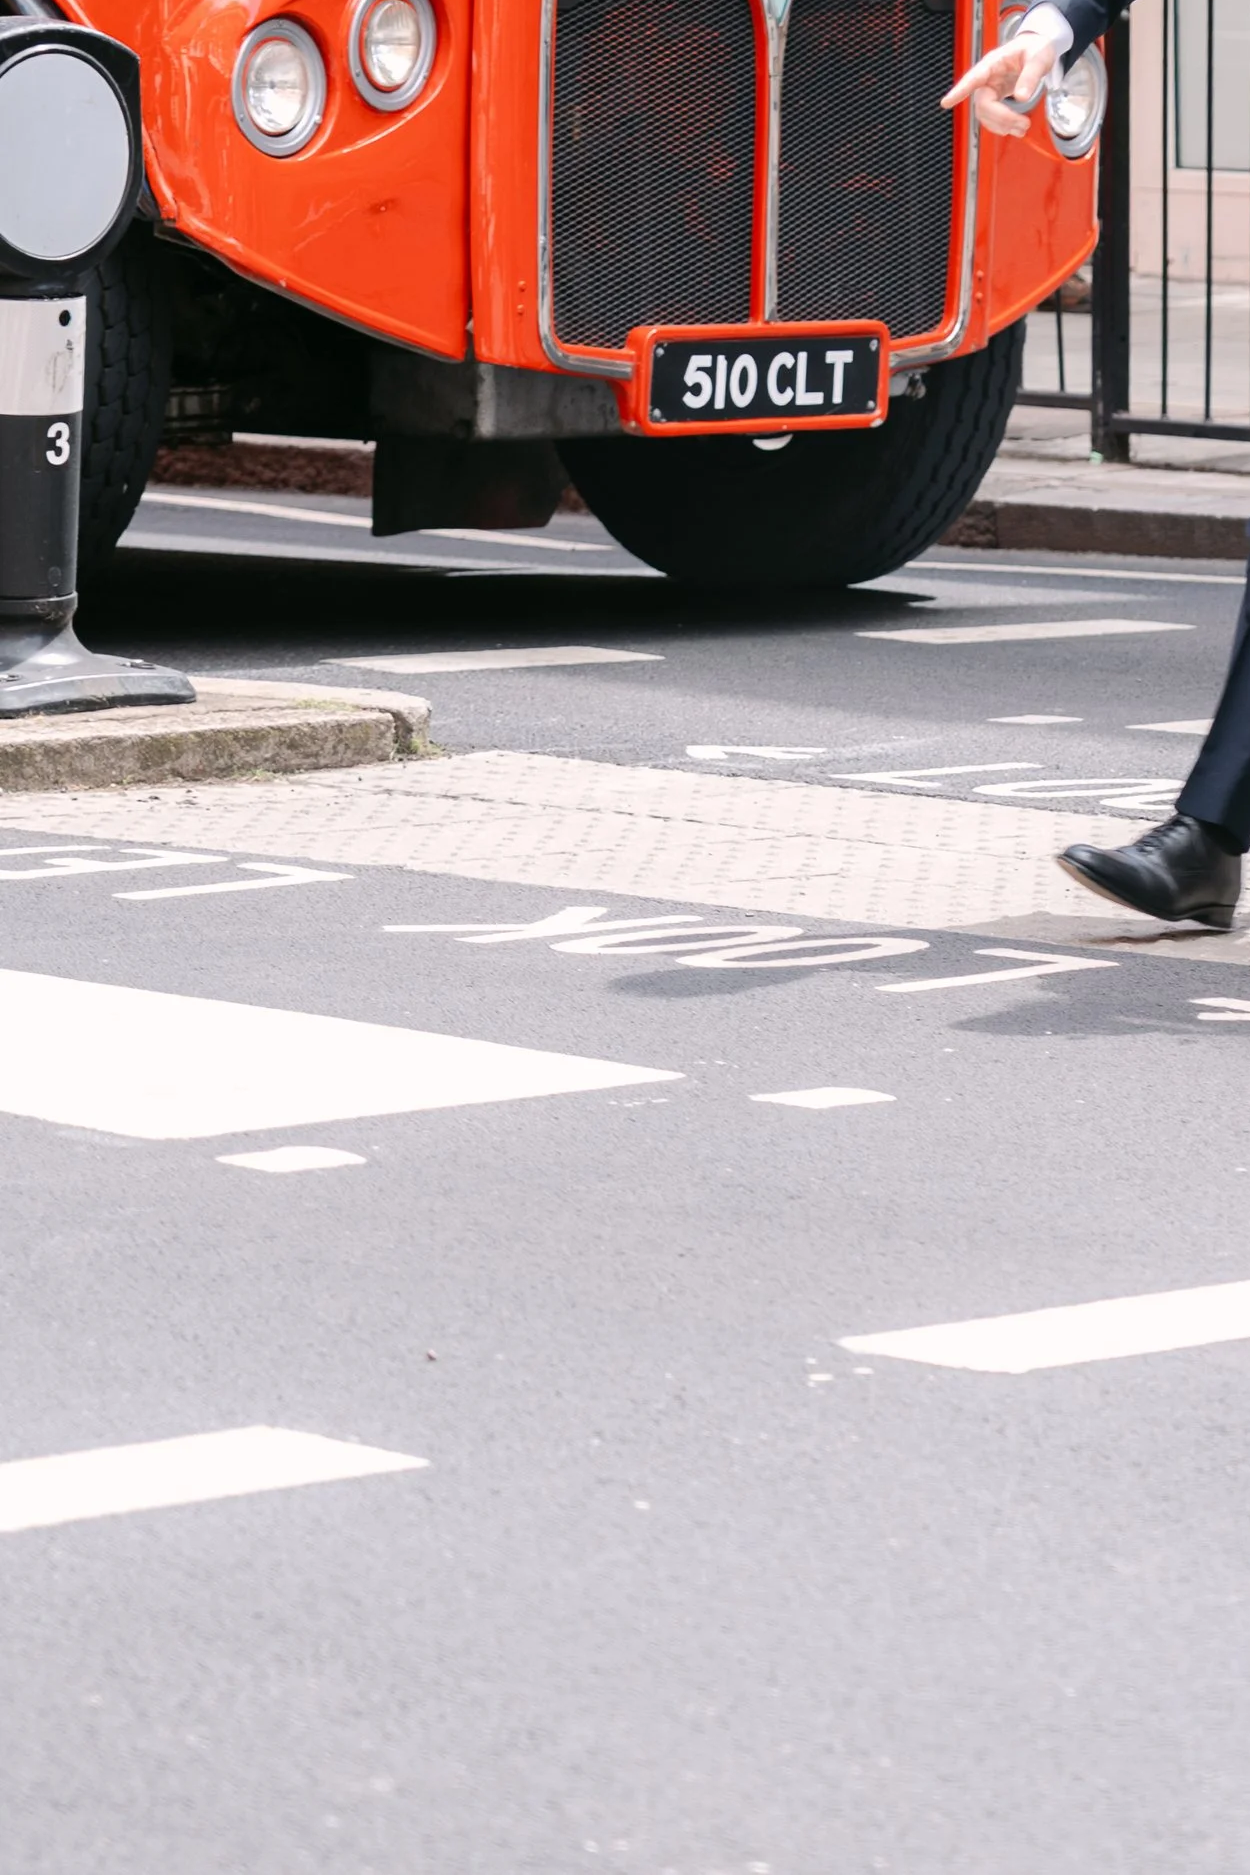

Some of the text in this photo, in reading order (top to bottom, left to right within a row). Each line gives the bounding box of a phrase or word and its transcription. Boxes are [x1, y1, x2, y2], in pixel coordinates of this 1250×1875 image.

[682, 349, 854, 411] 510 CLT
[46, 422, 70, 466] 3
